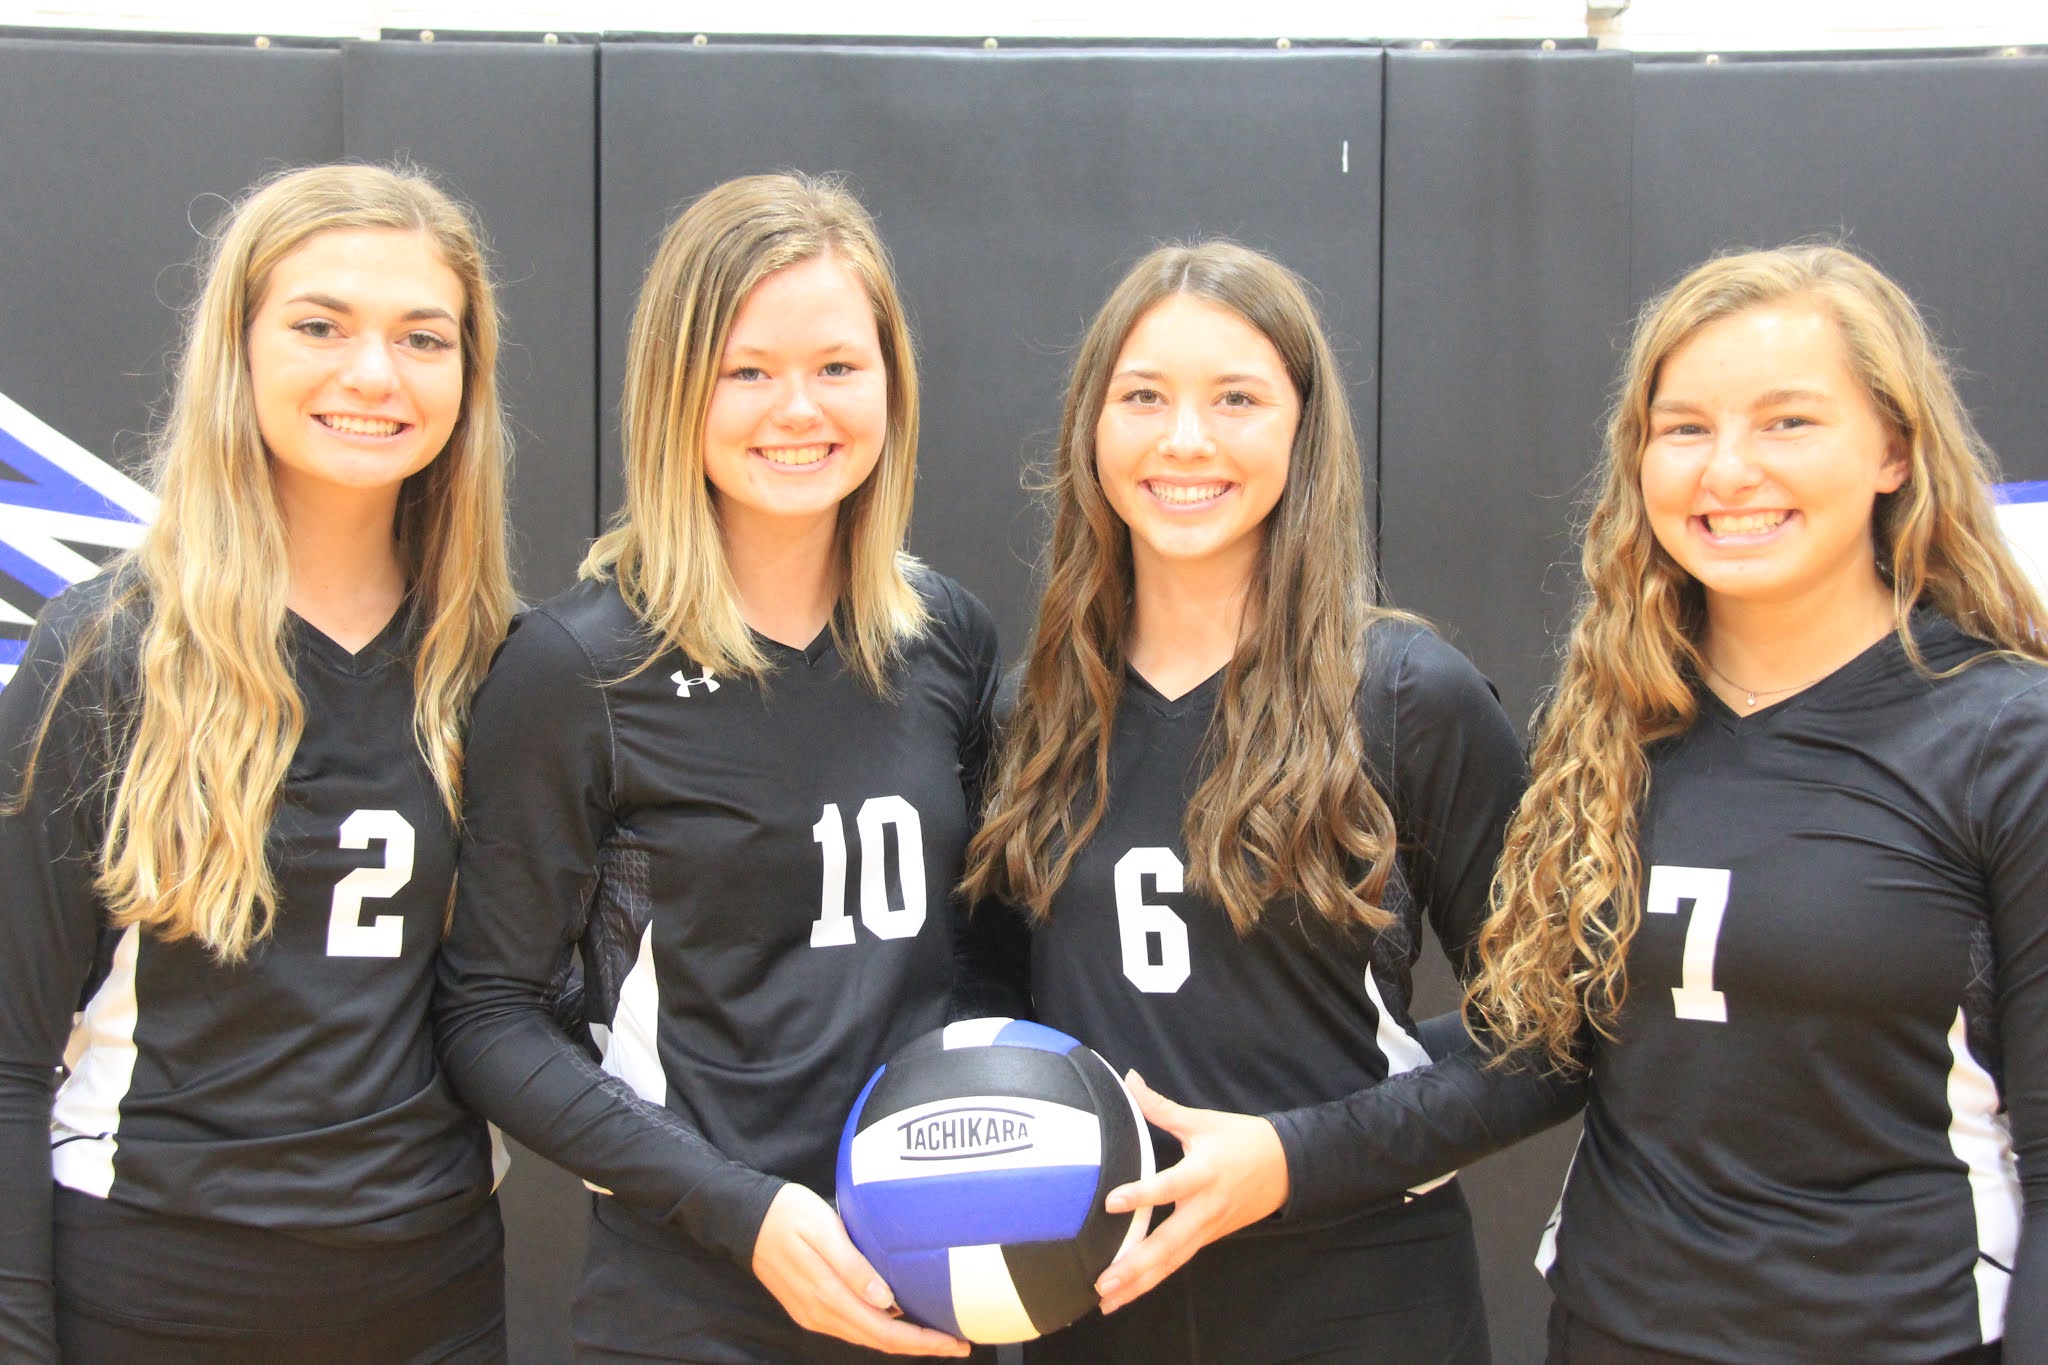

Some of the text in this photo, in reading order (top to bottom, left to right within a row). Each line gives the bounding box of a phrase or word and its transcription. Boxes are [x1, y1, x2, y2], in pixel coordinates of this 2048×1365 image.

[326, 810, 415, 957] 2
[810, 795, 926, 948] 10
[1114, 847, 1191, 993] 6
[1647, 865, 1731, 1022] 7
[899, 1116, 1029, 1151] TACHIKARA
